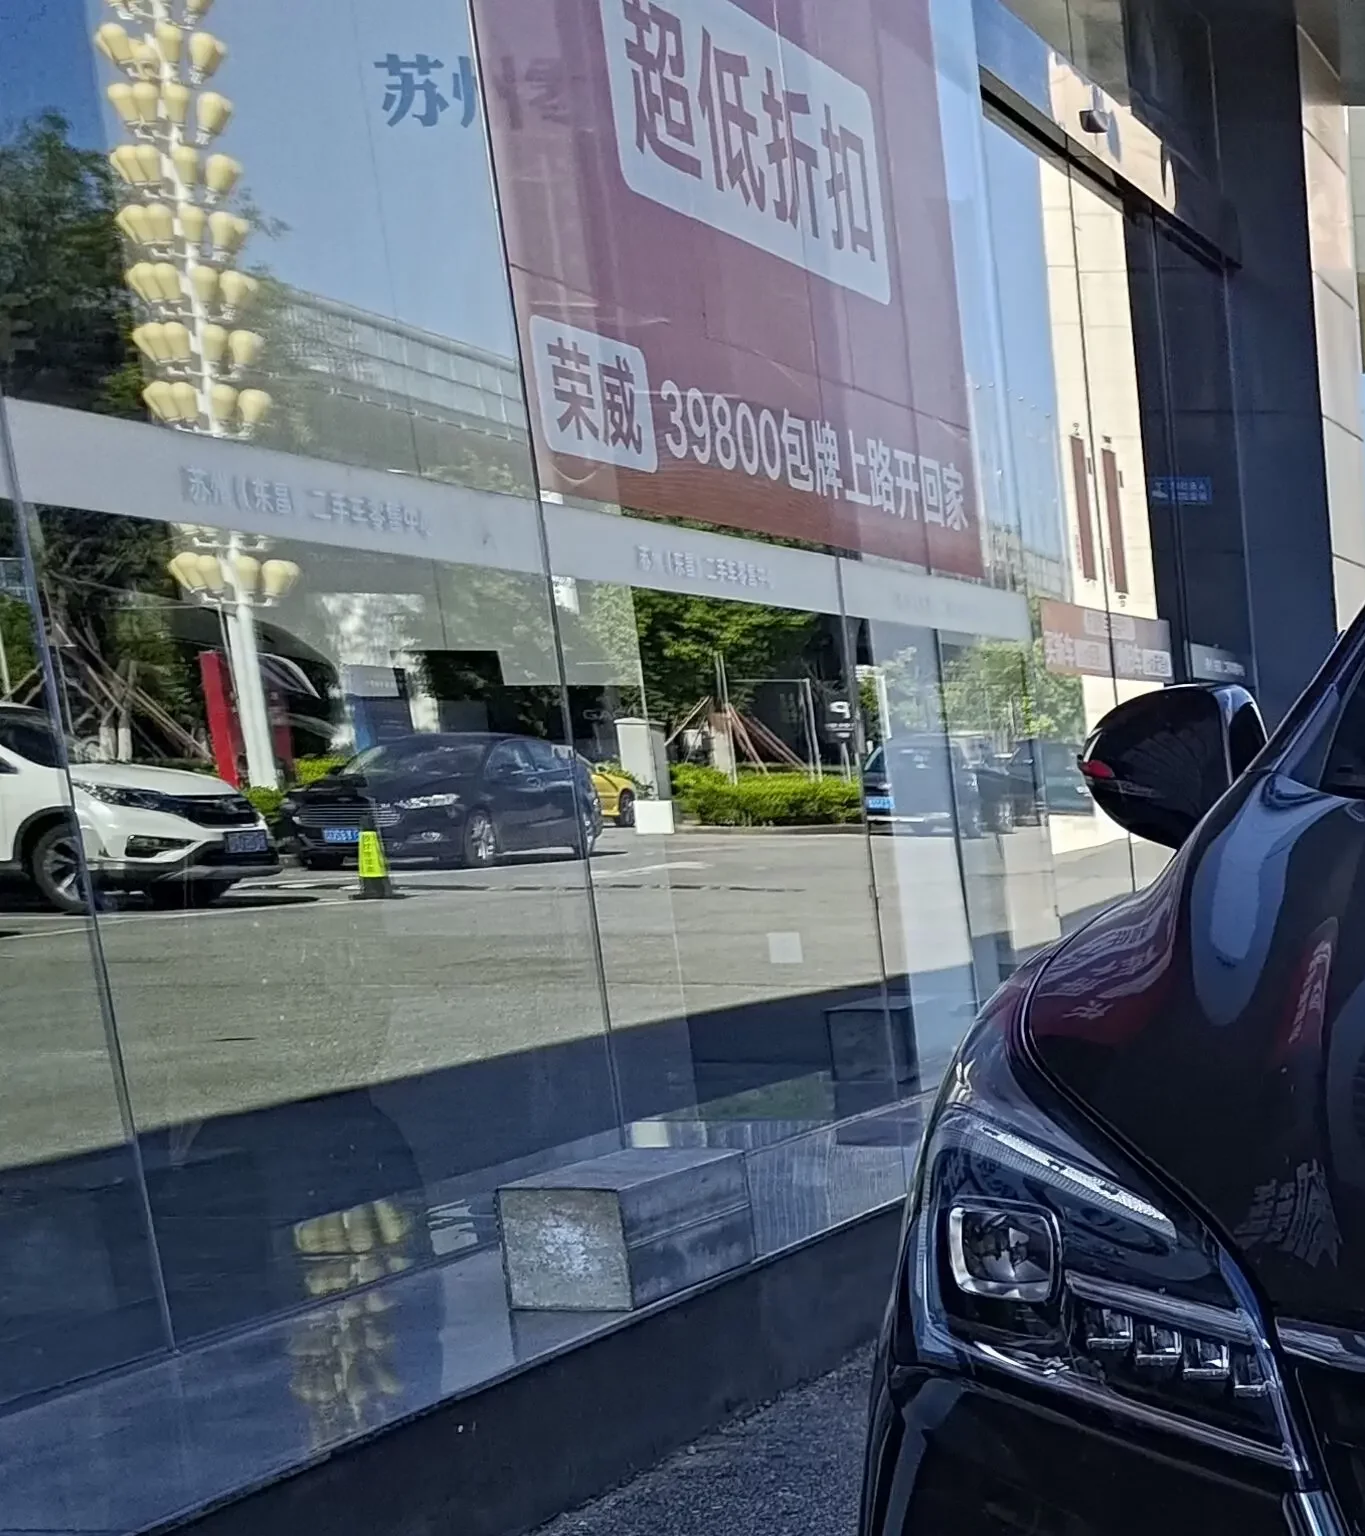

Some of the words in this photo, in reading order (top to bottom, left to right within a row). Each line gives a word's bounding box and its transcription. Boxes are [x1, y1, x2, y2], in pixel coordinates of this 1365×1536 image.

[622, 0, 876, 262] 超低折扣
[546, 337, 643, 456] 荣威
[661, 380, 968, 532] 39800包牌上路开回家
